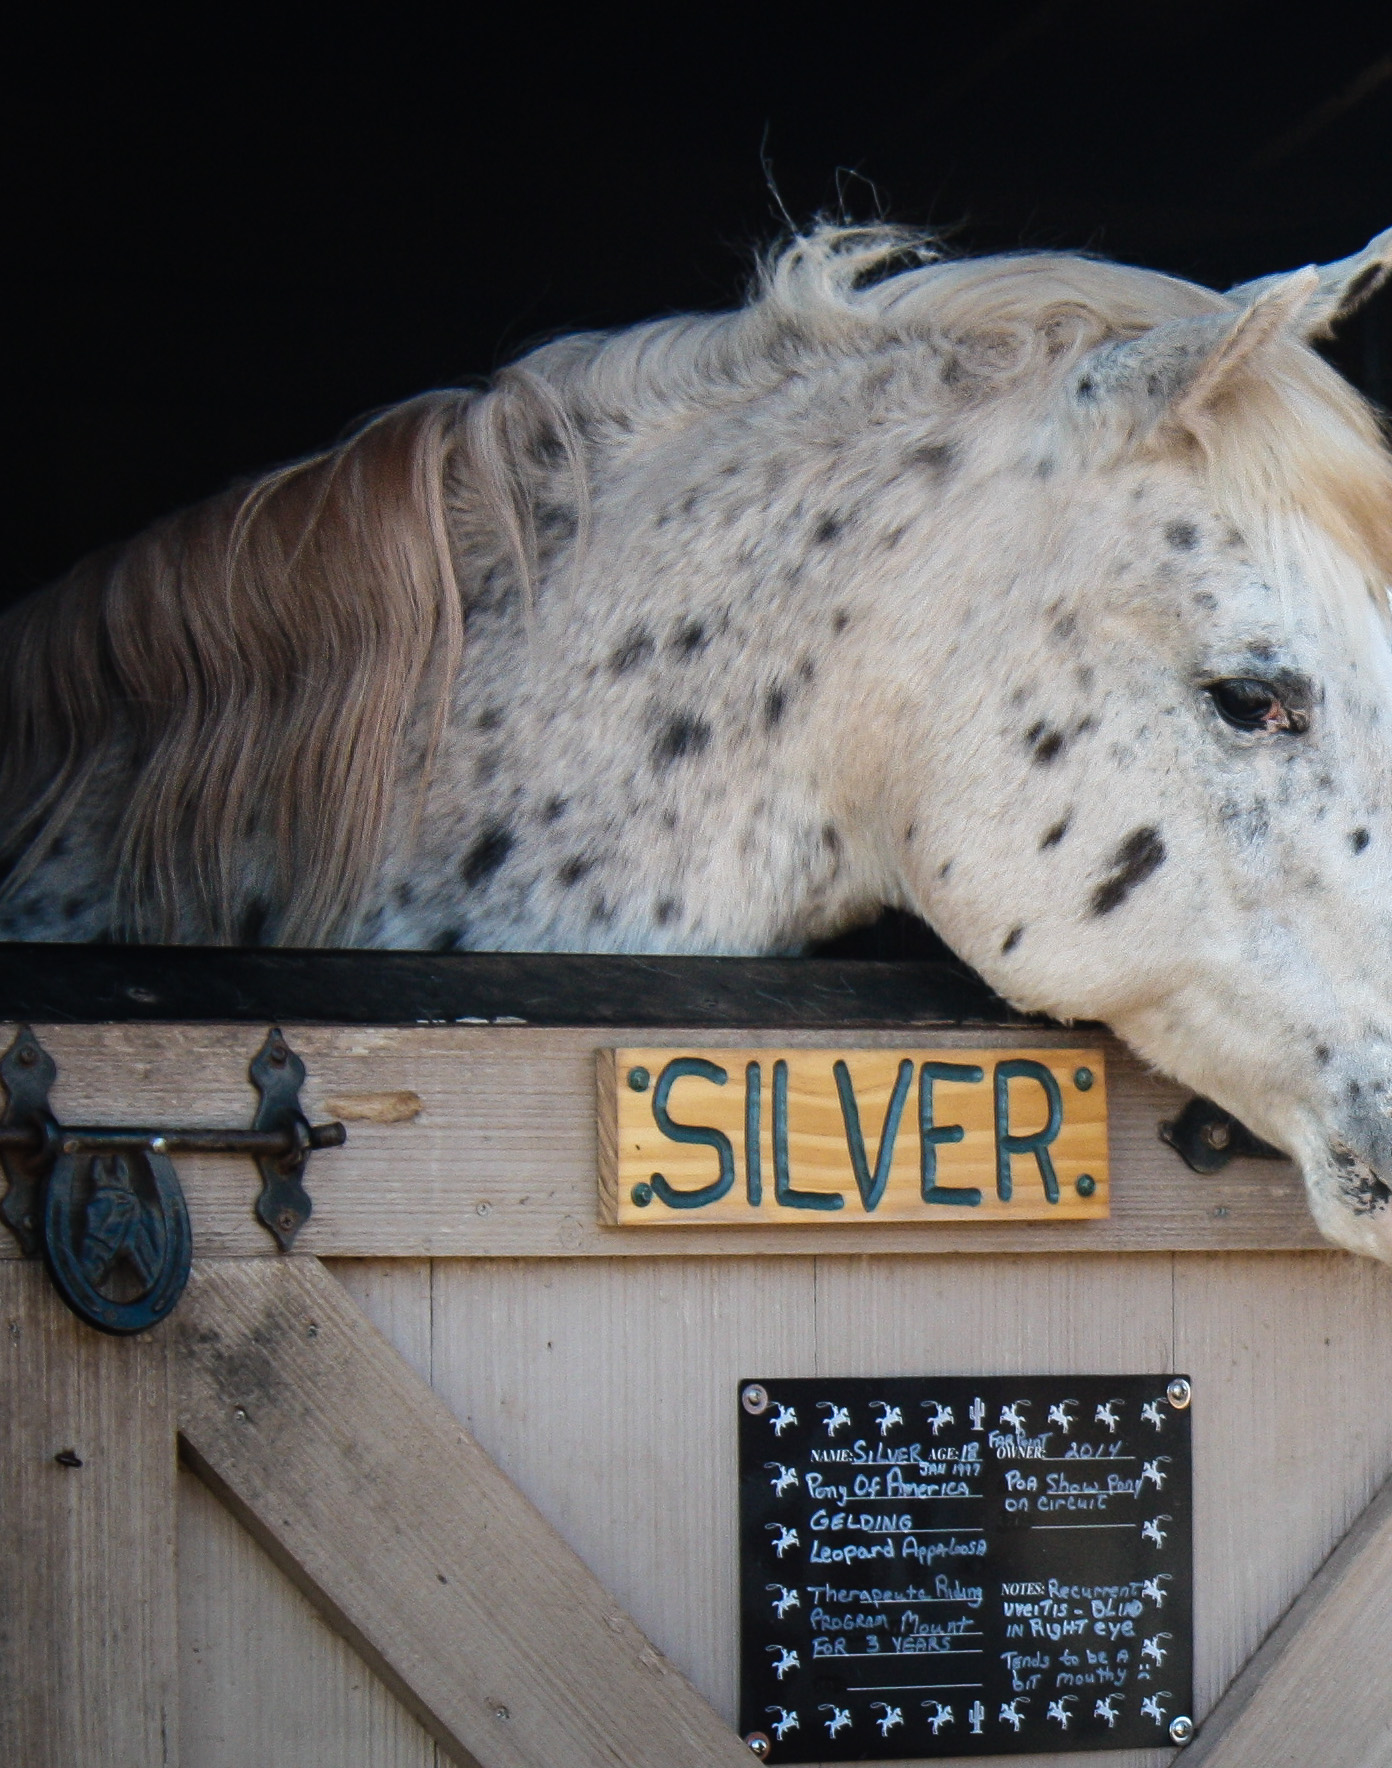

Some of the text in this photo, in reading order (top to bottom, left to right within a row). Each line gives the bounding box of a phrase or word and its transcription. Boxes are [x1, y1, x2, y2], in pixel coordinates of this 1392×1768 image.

[651, 1057, 1063, 1213] SILVER
[810, 1449, 853, 1463] NAME:
[928, 1448, 959, 1461] AGE:
[960, 1441, 980, 1462] 18
[996, 1441, 1122, 1460] OWNER: 2014
[919, 1462, 946, 1477] JAN
[805, 1472, 848, 1506] Pony
[1045, 1472, 1099, 1493] Show
[1107, 1473, 1143, 1500] Pony
[1005, 1497, 1029, 1512] on
[809, 1508, 913, 1533] GELDING
[809, 1537, 896, 1565] Leopard
[1001, 1582, 1046, 1596] NOTES:
[1091, 1598, 1143, 1619] BLIND
[901, 1609, 974, 1634] Mount
[1093, 1620, 1136, 1641] eye
[865, 1634, 879, 1652] 3
[892, 1636, 950, 1653] YEARS
[1000, 1651, 1050, 1670] Tends
[1058, 1649, 1079, 1667] to
[1085, 1649, 1109, 1665] be
